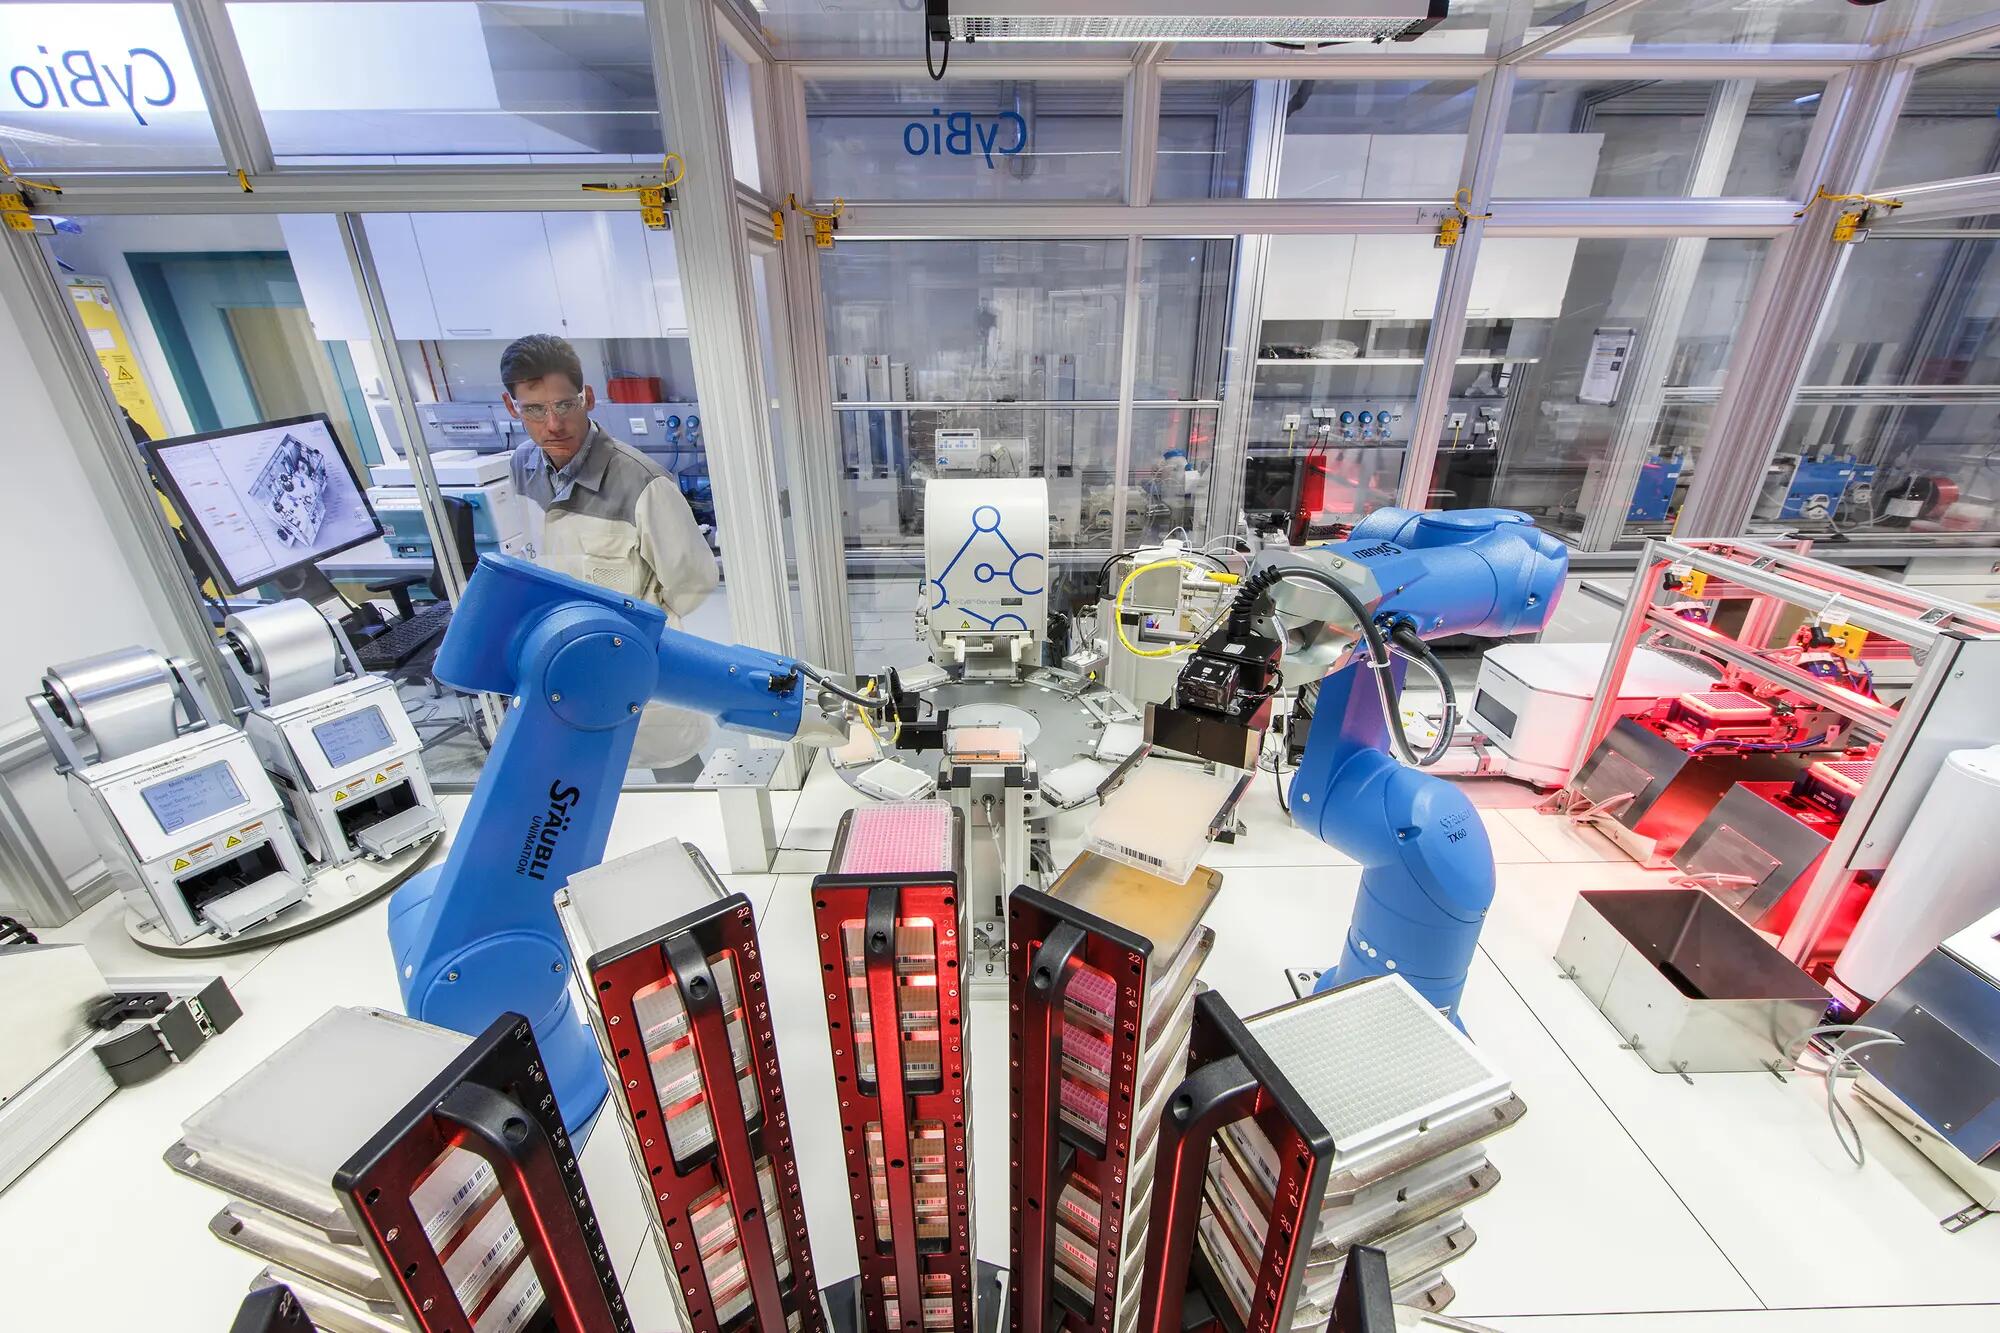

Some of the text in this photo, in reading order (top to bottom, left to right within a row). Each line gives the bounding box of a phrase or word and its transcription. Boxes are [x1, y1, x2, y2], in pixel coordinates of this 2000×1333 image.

[1352, 542, 1402, 560] STÄUBLI
[528, 778, 580, 881] STÄUBLI
[1448, 828, 1467, 844] TX60
[516, 815, 543, 876] UNIMATION
[941, 887, 953, 895] 22
[737, 906, 750, 918] 22
[743, 940, 754, 951] 21
[1128, 952, 1141, 964] 22
[749, 972, 761, 983] 20
[1126, 987, 1136, 998] 21
[755, 1001, 766, 1012] 19
[948, 1009, 958, 1017] 18
[515, 1022, 528, 1040] 22
[1123, 1020, 1135, 1031] 20
[761, 1031, 771, 1041] 18
[1122, 1052, 1132, 1061] 19
[528, 1060, 539, 1076] 21
[765, 1058, 775, 1069] 17
[771, 1086, 781, 1096] 16
[1120, 1082, 1130, 1092] 18
[540, 1094, 552, 1110] 20
[775, 1111, 785, 1121] 15
[1117, 1111, 1127, 1120] 17
[552, 1126, 563, 1141] 19
[780, 1137, 789, 1146] 14
[1116, 1140, 1125, 1150] 16
[1296, 1138, 1310, 1160] 22
[564, 1158, 574, 1172] 18
[784, 1161, 794, 1170] 13
[1113, 1165, 1122, 1176] 15
[788, 1183, 798, 1193] 12
[1288, 1177, 1299, 1195] 21
[574, 1187, 584, 1202] 17
[793, 1206, 801, 1215] 11
[584, 1216, 594, 1230] 16
[1109, 1216, 1119, 1226] 13
[1280, 1214, 1292, 1234] 20
[797, 1227, 805, 1237] 10
[1274, 1249, 1284, 1266] 19
[1104, 1284, 1113, 1293] 10
[1267, 1282, 1276, 1301] 18
[280, 1291, 293, 1318] 22
